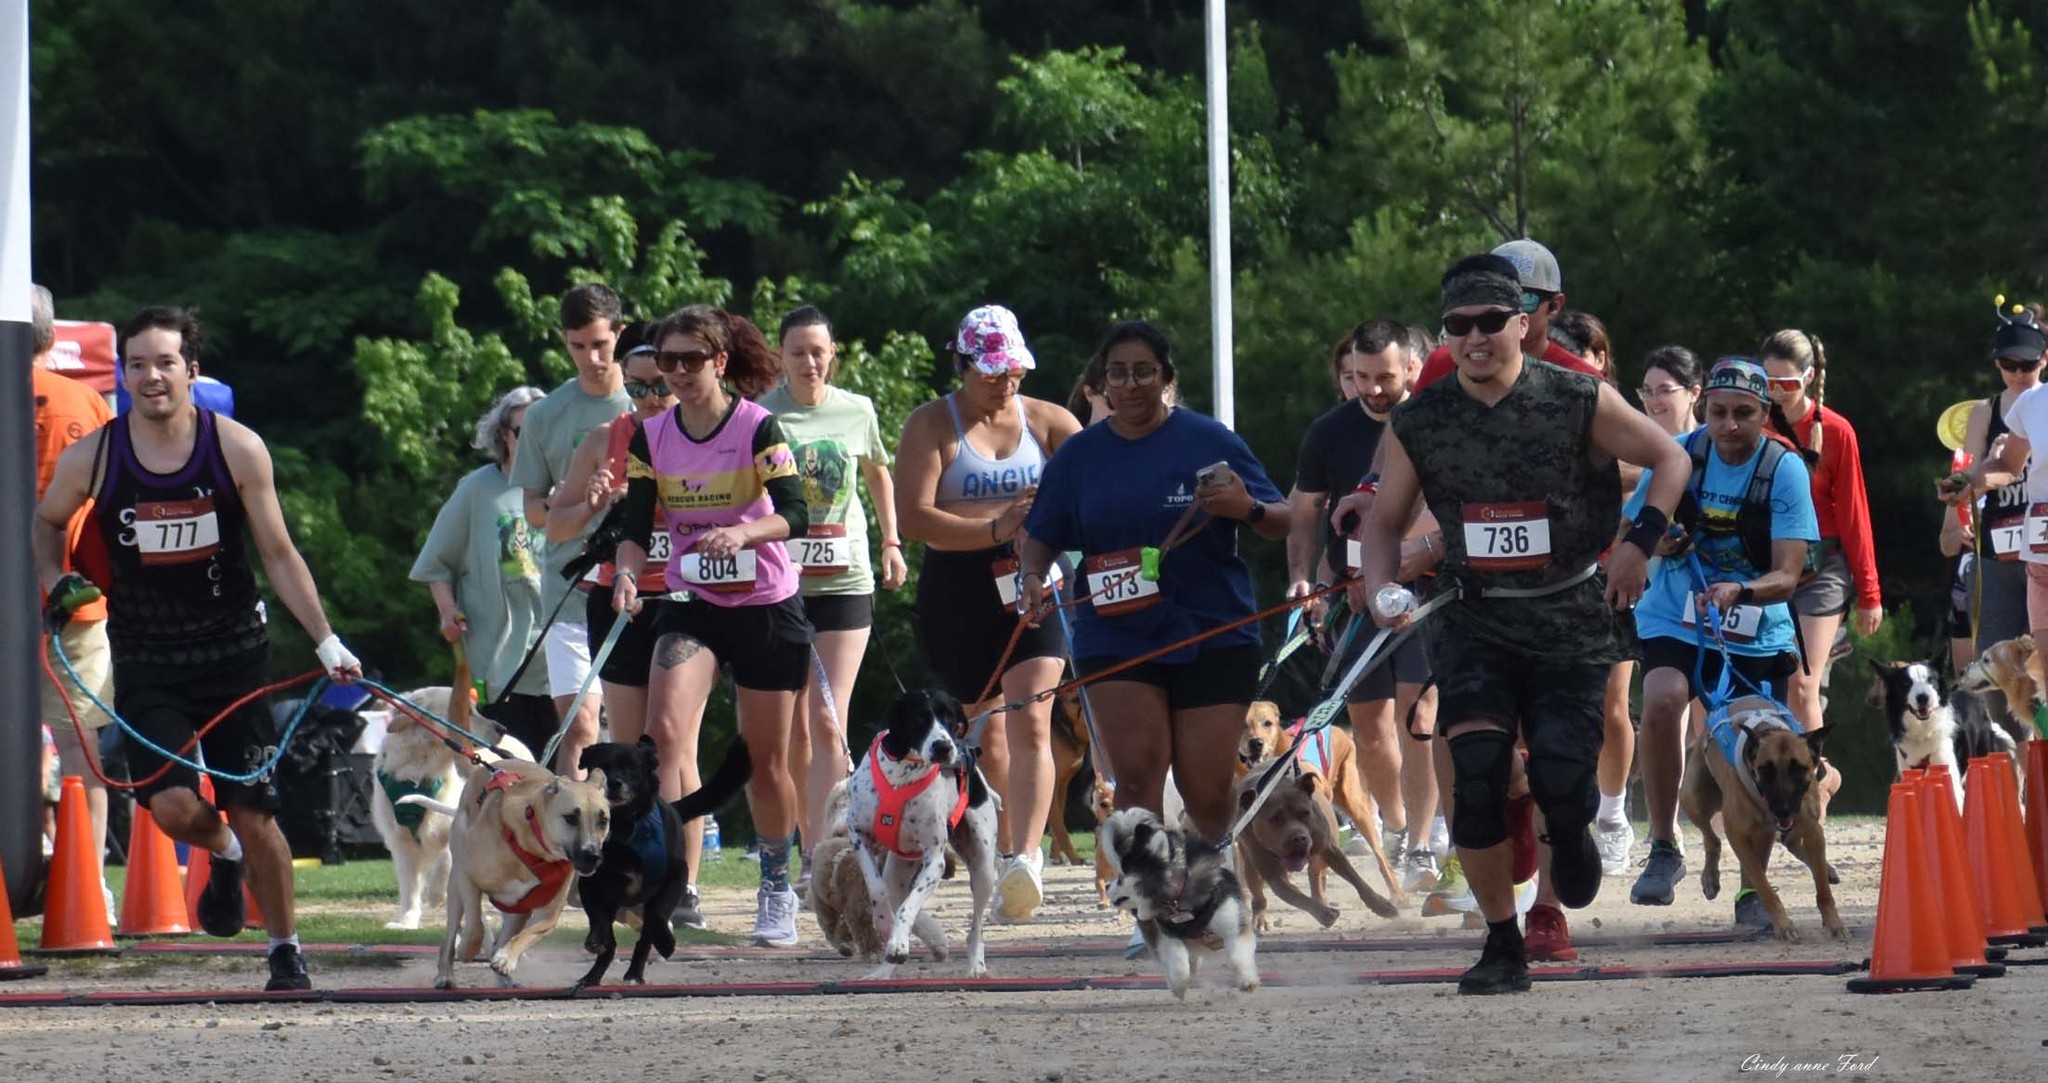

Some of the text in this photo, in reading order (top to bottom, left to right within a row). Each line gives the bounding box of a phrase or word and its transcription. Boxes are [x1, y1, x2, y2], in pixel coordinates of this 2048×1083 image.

[1700, 491, 1717, 502] OT
[155, 521, 198, 549] 777
[647, 535, 669, 558] 23
[1483, 525, 1529, 554] 736
[2004, 529, 2023, 549] 71
[800, 542, 834, 564] 725
[698, 553, 738, 581] 804
[1102, 571, 1139, 600] 873
